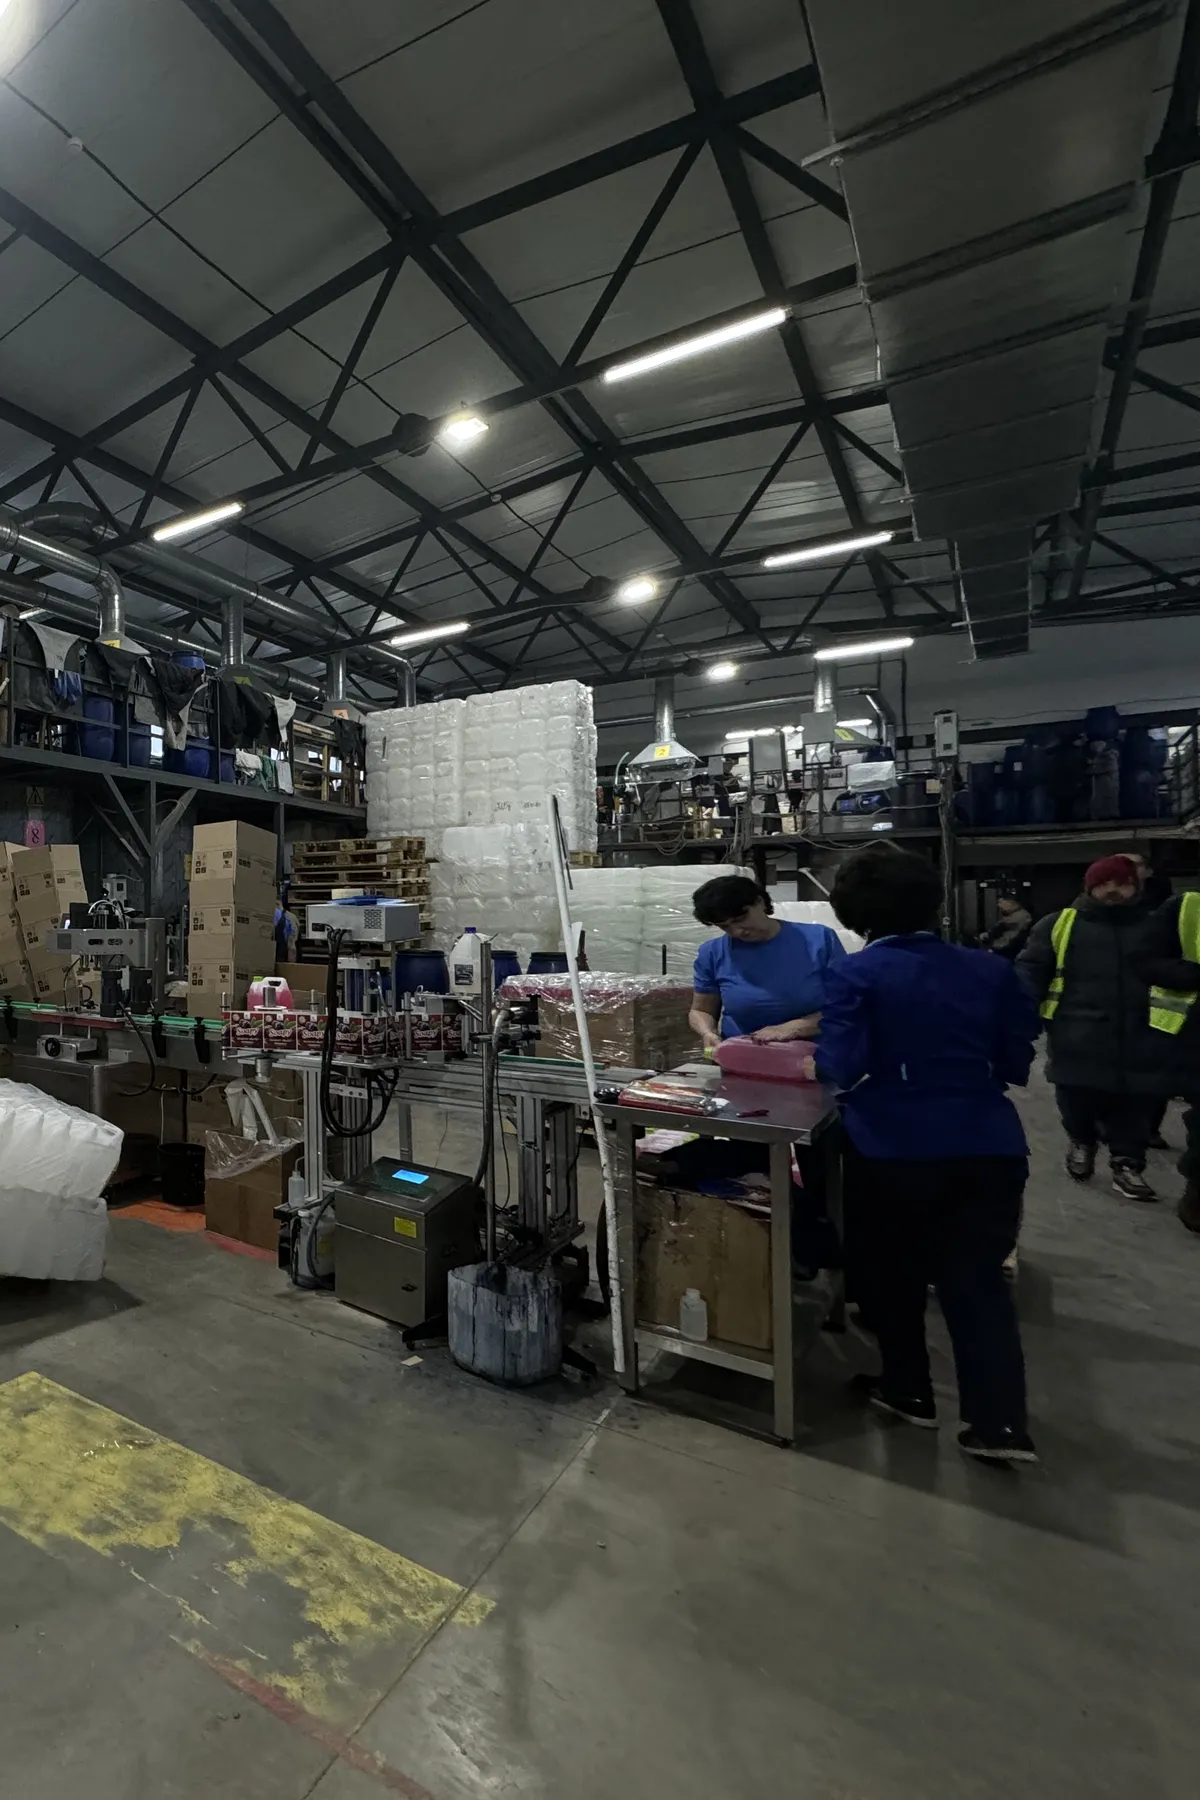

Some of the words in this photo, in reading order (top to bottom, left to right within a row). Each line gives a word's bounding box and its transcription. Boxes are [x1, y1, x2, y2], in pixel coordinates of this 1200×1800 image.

[31, 828, 40, 844] 8
[235, 1027, 259, 1037] Soapy
[268, 1028, 293, 1038] Soapy
[413, 1029, 439, 1039] Soapy
